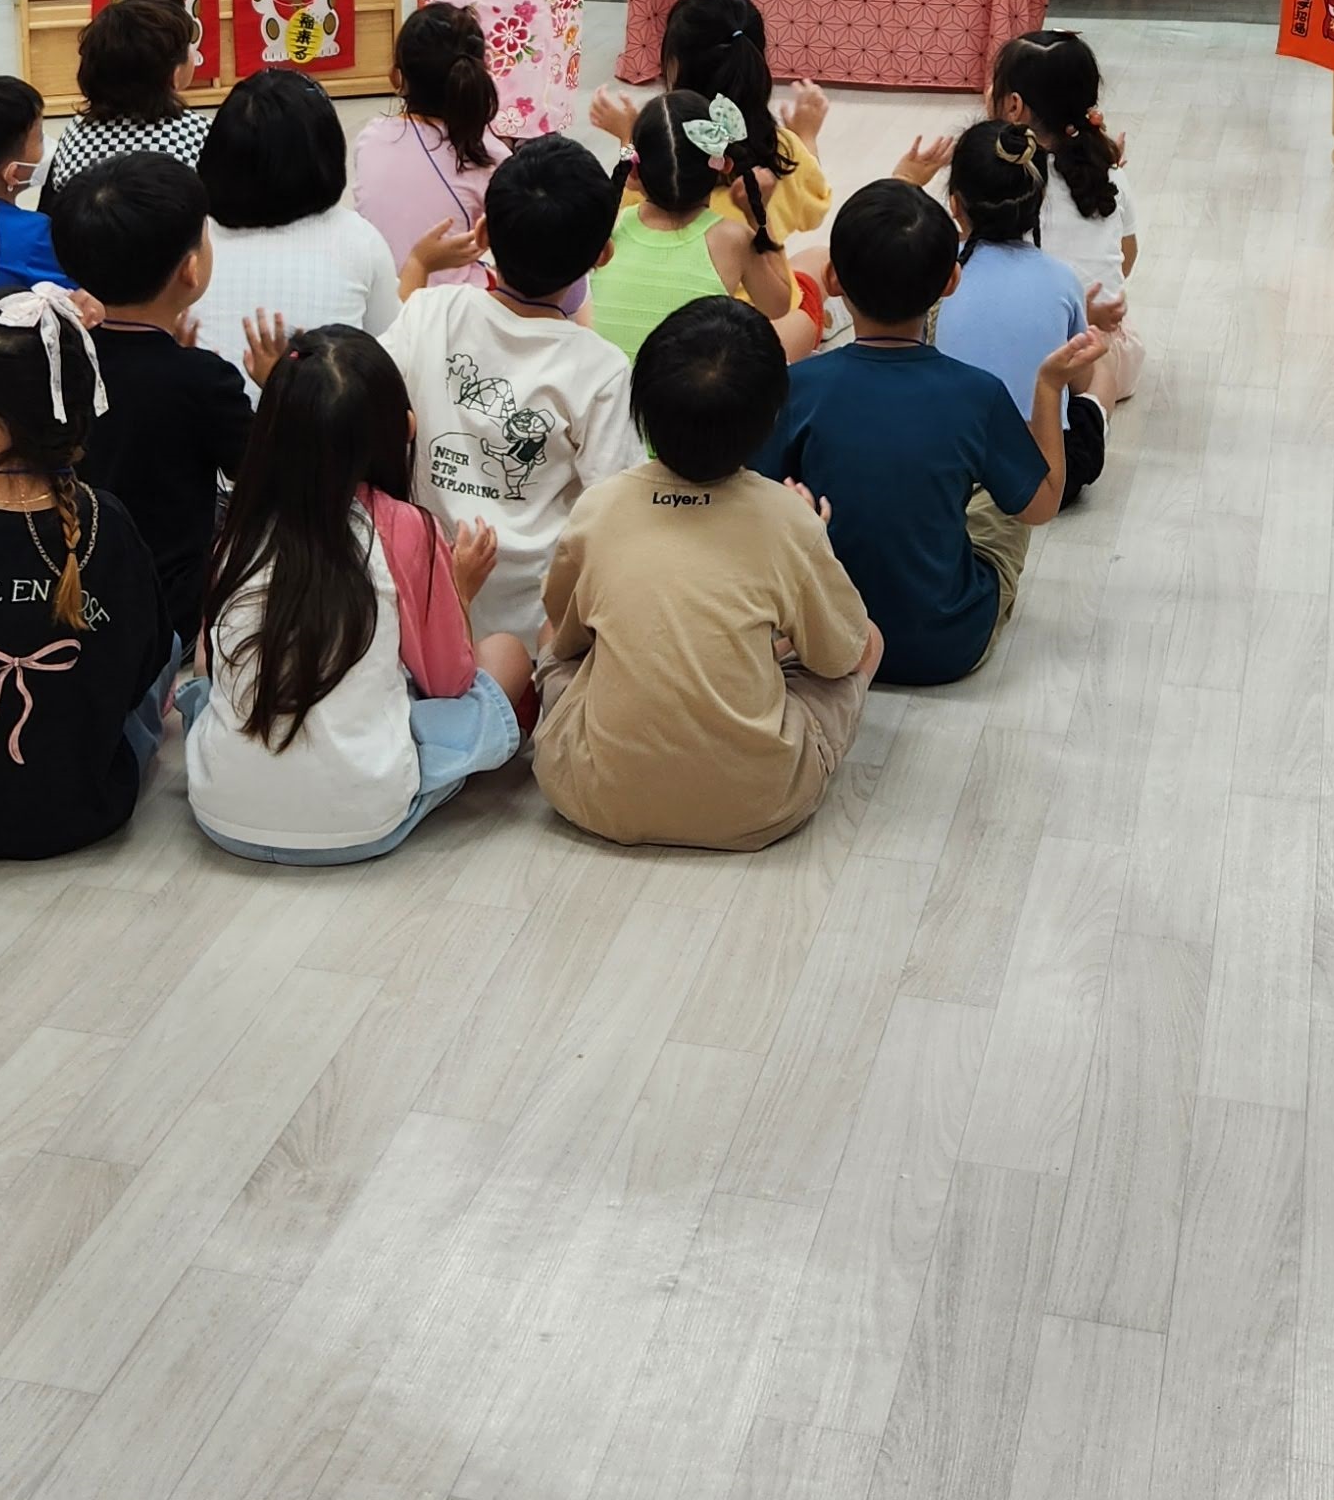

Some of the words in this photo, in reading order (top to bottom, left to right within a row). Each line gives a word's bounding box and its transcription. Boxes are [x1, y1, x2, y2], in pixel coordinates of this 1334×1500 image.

[293, 12, 316, 61] 福来る
[434, 445, 469, 467] NEVER
[431, 460, 457, 477] STOP
[430, 473, 501, 500] EXPLORING
[652, 491, 711, 508] Layer.1
[11, 579, 52, 603] EN
[78, 589, 111, 632] OSE
